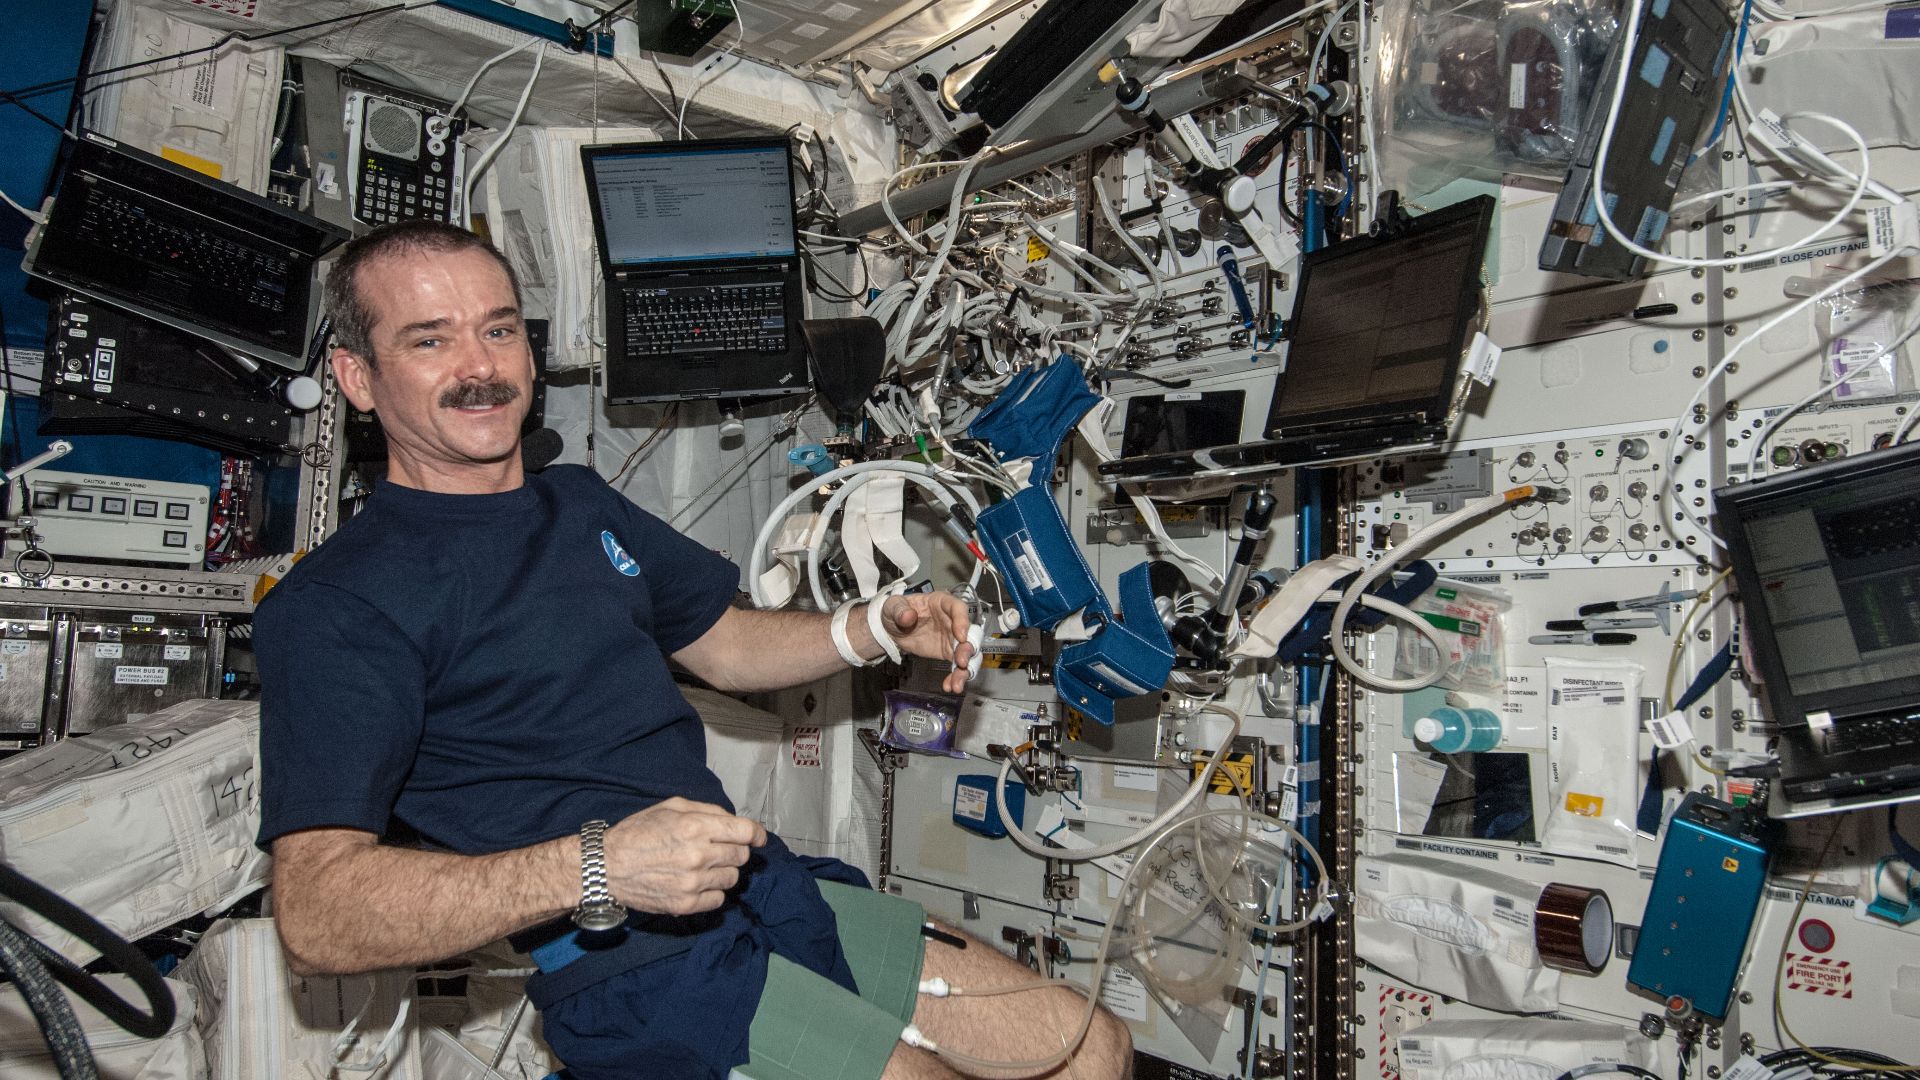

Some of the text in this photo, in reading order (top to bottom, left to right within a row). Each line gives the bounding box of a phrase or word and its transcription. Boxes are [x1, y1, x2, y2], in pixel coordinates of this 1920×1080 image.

[1779, 241, 1868, 265] CLOSE-OUT PANE
[1423, 844, 1498, 860] FACILITY CONTAINER
[1161, 868, 1203, 902] Reset
[1795, 893, 1855, 908] DATA MANA
[1796, 969, 1841, 983] FIRE PORT
